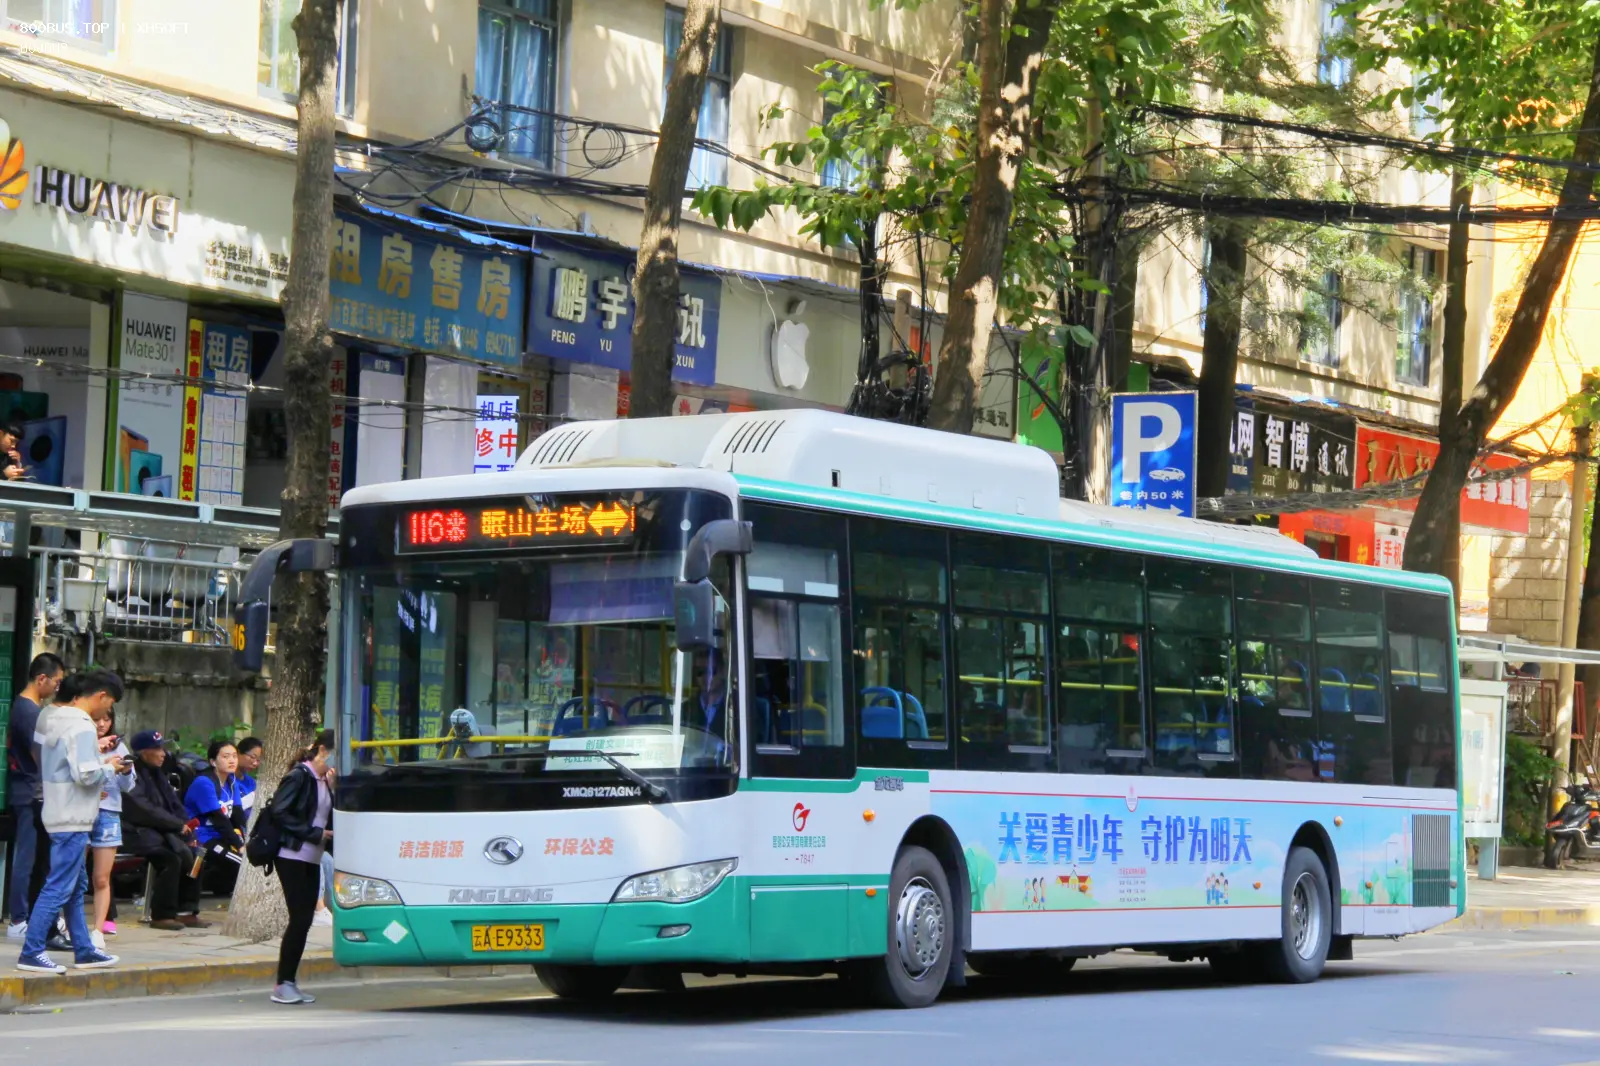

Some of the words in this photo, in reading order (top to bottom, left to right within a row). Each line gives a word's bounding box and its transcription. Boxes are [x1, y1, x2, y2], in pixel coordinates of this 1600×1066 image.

[35, 165, 179, 237] HUAWEI
[125, 318, 176, 342] HUAWEI
[23, 345, 69, 358] HUAWEI
[125, 338, 169, 362] Mate30
[207, 330, 249, 374] 租房
[551, 329, 576, 346] PENG
[599, 338, 613, 353] YU
[675, 355, 695, 369] XUN
[1122, 402, 1182, 484] P
[1265, 414, 1310, 474] 智博
[562, 786, 642, 798] XMQ6127AGN4
[399, 840, 464, 858] 清洁能源
[544, 838, 614, 856] 环保公交
[998, 812, 1124, 864] 关爱青少年
[1140, 815, 1252, 863] 守护为明天
[448, 889, 496, 903] KING
[498, 888, 554, 903] LONG
